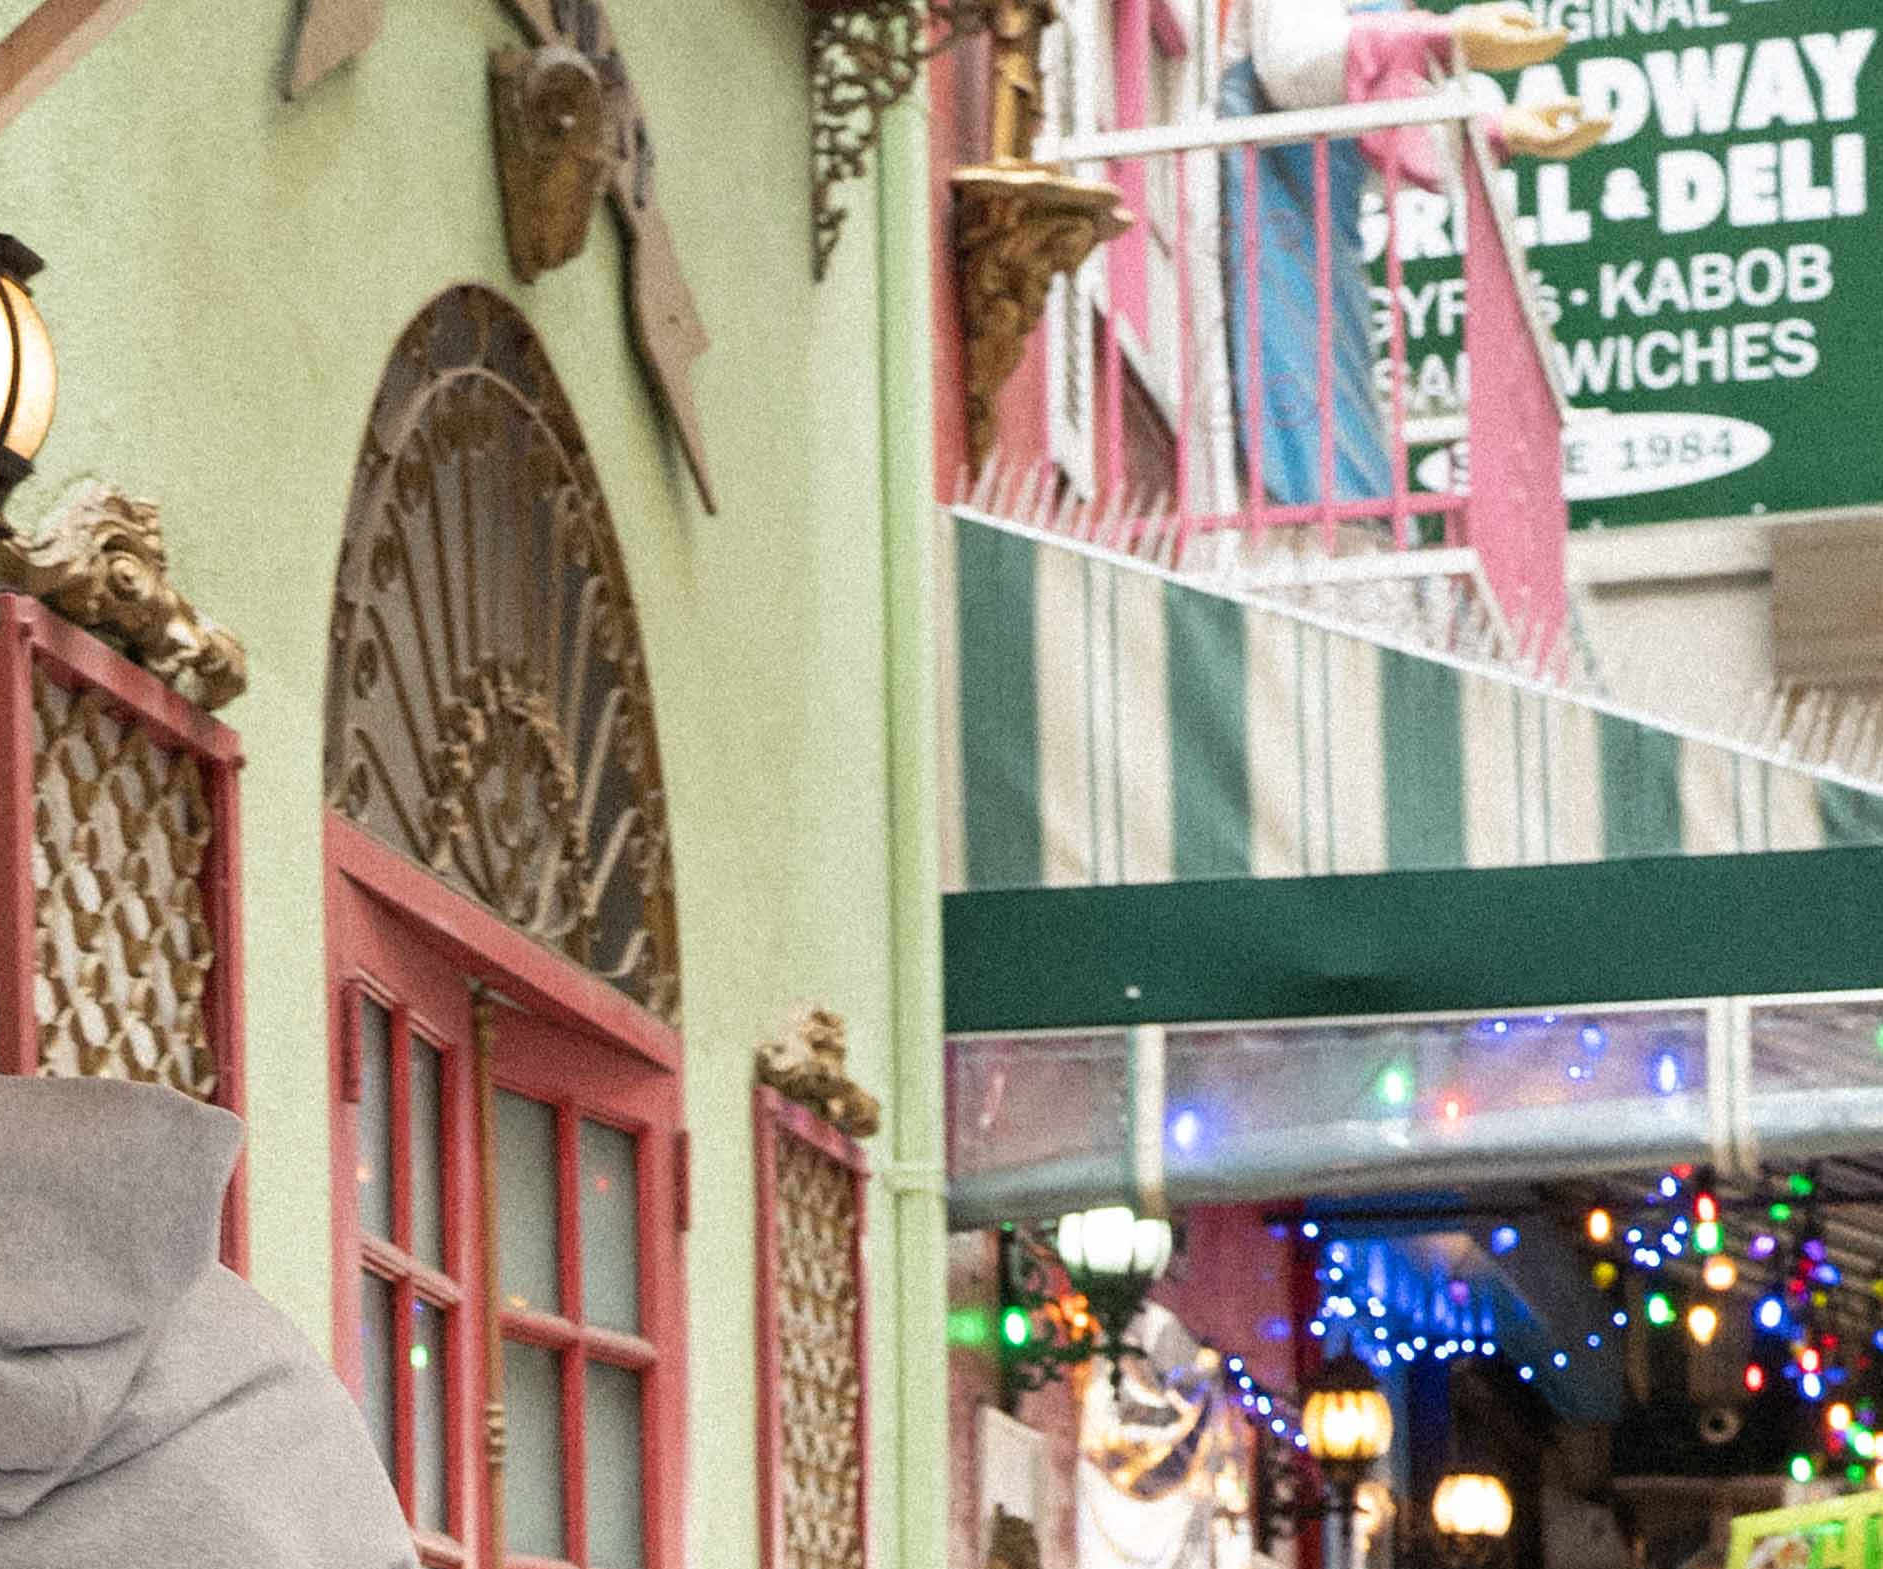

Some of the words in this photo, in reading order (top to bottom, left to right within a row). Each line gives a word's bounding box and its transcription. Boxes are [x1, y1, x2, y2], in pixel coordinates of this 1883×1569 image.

[1454, 28, 1877, 146] DWAY
[1601, 168, 1652, 220] &
[1657, 133, 1868, 234] DELI
[1600, 244, 1834, 319] KABOB
[1369, 319, 1819, 408] SAWICHES
[1622, 429, 1735, 474] 1984
